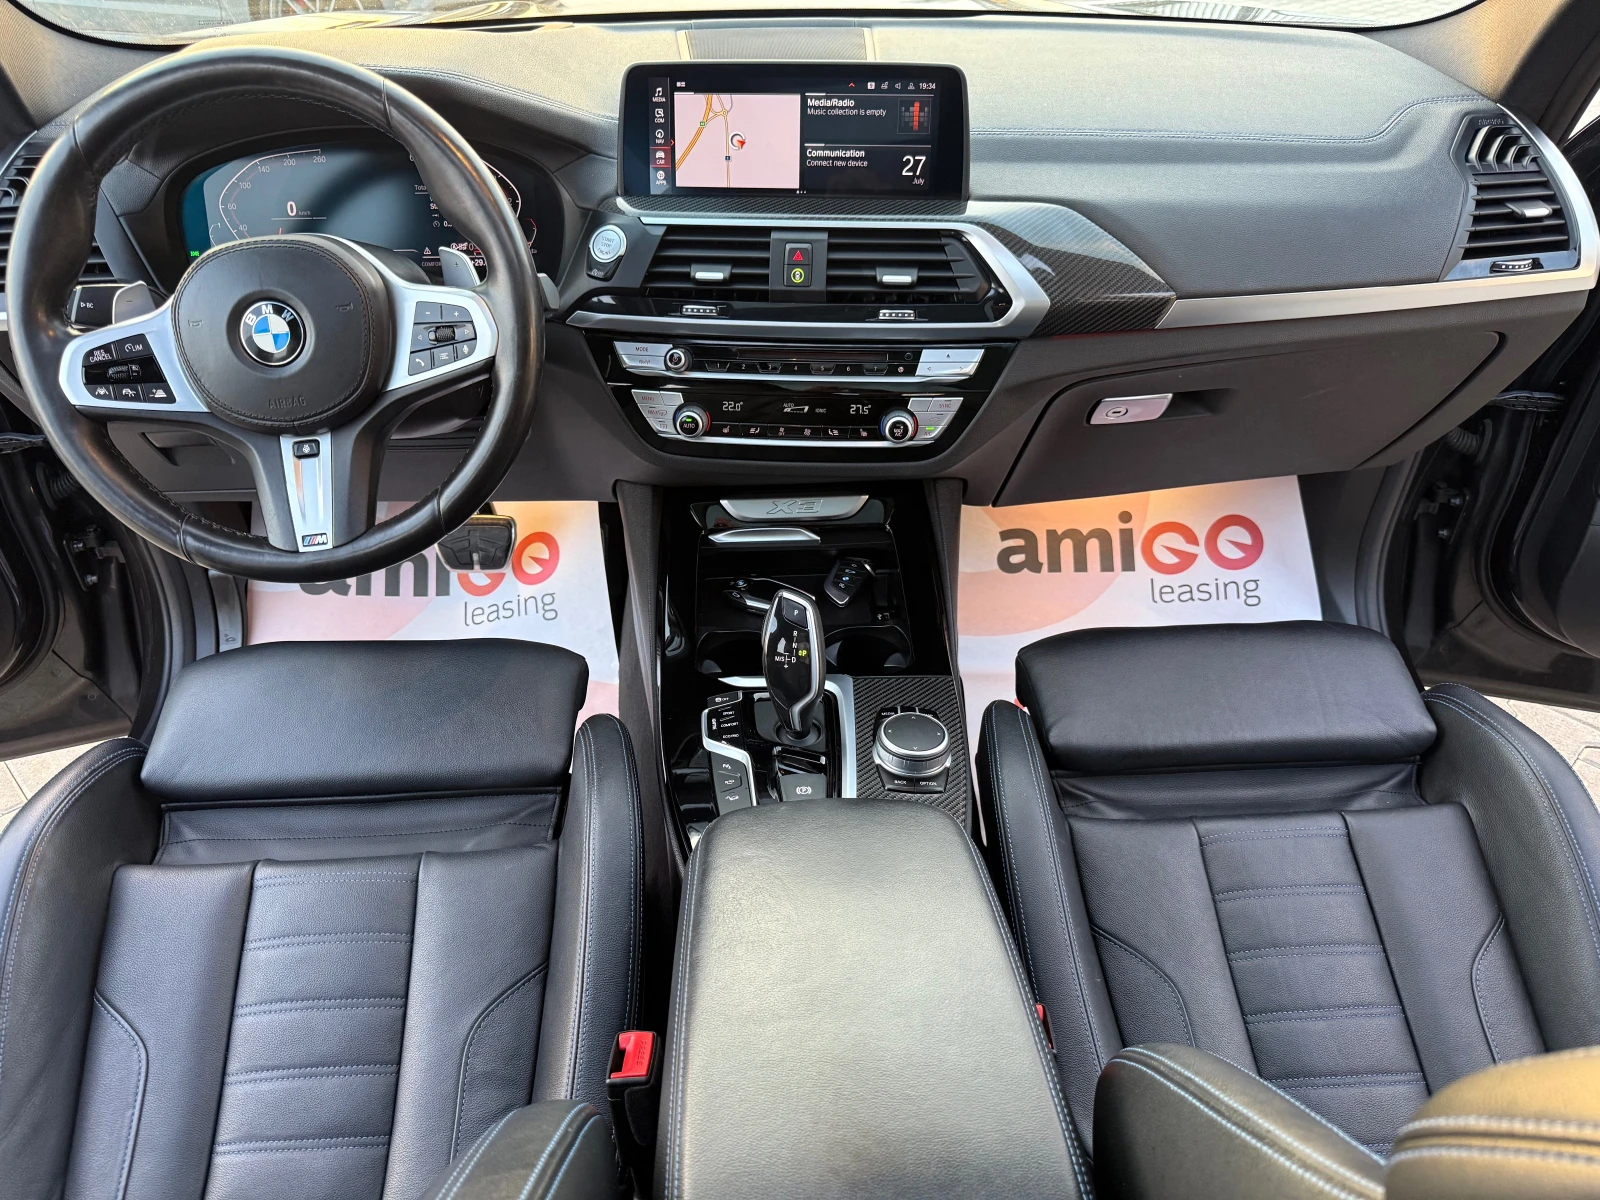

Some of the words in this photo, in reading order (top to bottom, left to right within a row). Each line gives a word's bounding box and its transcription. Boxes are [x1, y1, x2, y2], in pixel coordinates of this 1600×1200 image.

[919, 82, 936, 90] 19:34
[807, 98, 855, 107] Media/Radio
[807, 108, 826, 116] Music
[806, 149, 865, 158] Communication
[283, 158, 297, 166] 200
[312, 155, 327, 163] 260
[257, 165, 270, 173] 140
[902, 155, 926, 176] 27
[912, 177, 925, 186] July
[227, 203, 237, 211] 60
[286, 201, 297, 216] 0
[245, 304, 294, 325] BMW
[133, 343, 143, 352] LIM
[89, 353, 112, 363] CANCEL
[268, 397, 307, 410] AIRBAG
[766, 499, 823, 514] X3
[1149, 578, 1262, 607] leasing
[463, 592, 558, 626] leasing
